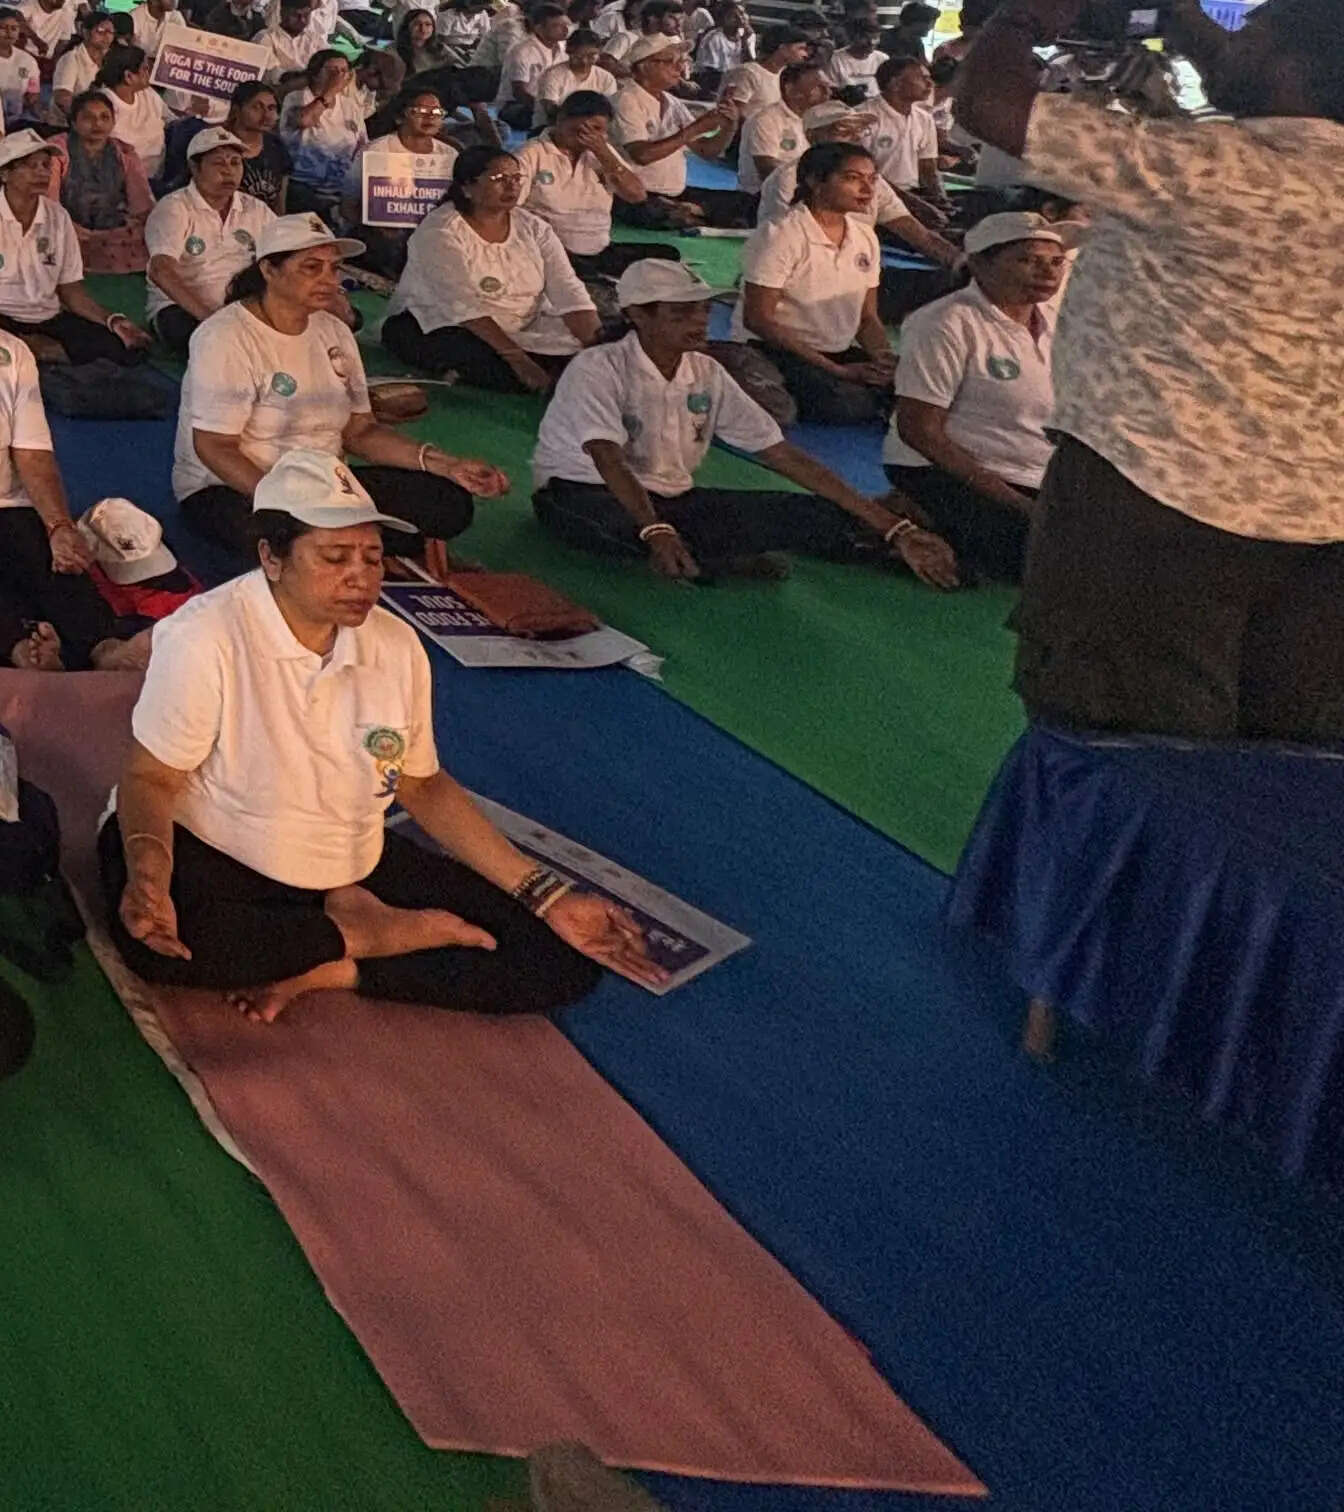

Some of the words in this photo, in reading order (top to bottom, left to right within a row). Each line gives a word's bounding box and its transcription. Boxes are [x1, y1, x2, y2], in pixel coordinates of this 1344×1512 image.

[164, 50, 192, 68] YOGA
[193, 59, 203, 71] IS
[205, 61, 226, 79] THE
[169, 67, 192, 82] FOR
[192, 71, 213, 89] THE
[214, 79, 238, 94] SOU
[386, 201, 425, 215] EXHALE
